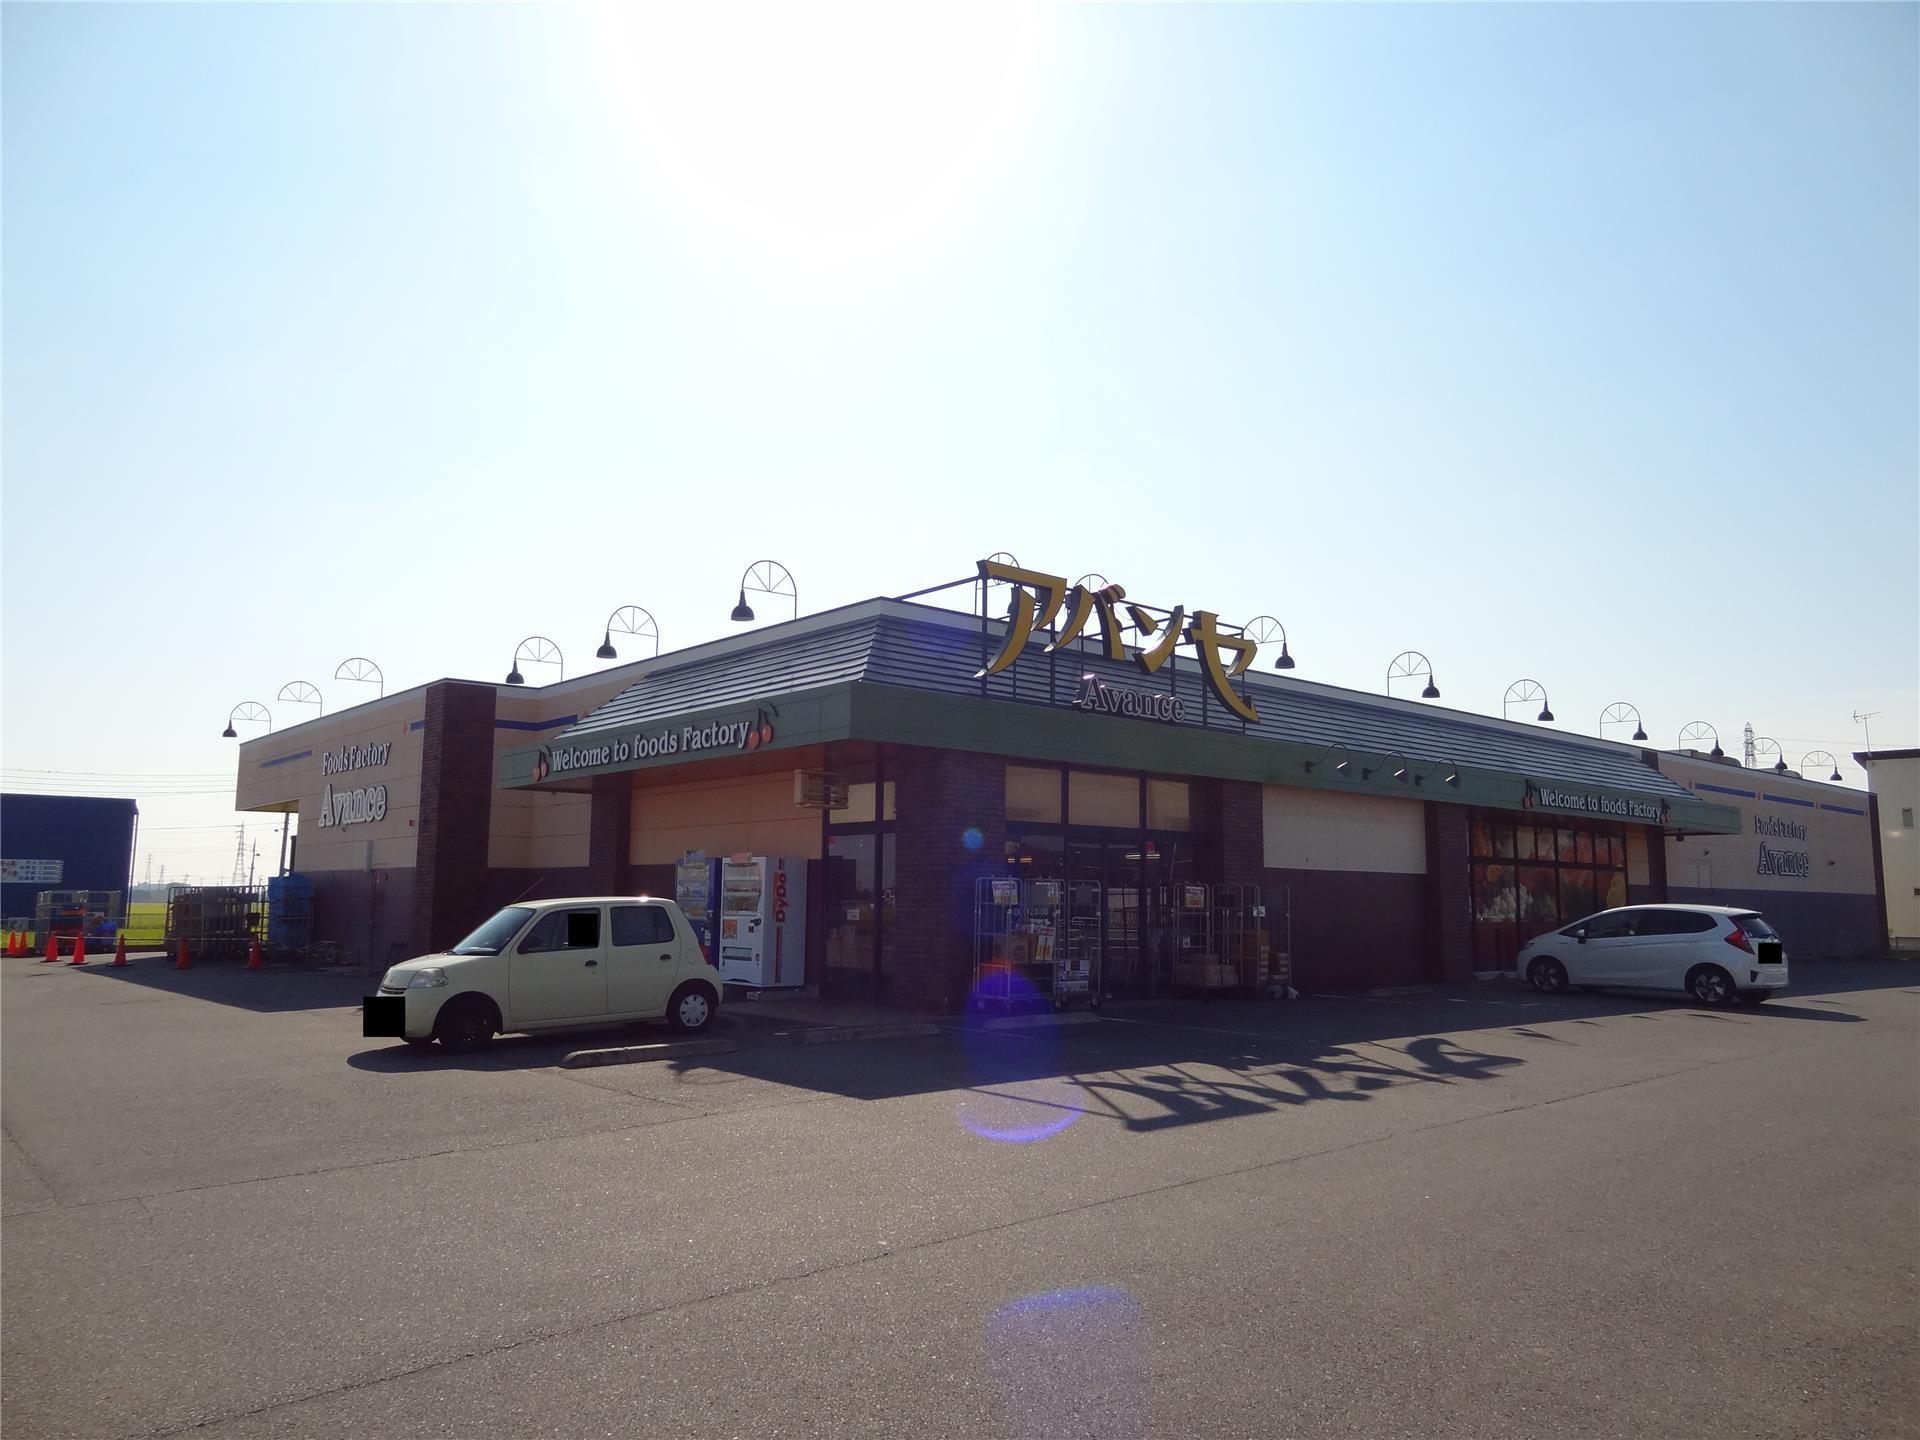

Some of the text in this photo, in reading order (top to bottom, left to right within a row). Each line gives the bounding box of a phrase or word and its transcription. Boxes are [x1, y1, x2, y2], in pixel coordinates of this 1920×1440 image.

[973, 560, 1259, 723] アバンセ
[1076, 673, 1185, 723] Avance
[322, 742, 392, 776] Foods Factory
[552, 719, 752, 772] Welcome to foods Factory
[318, 783, 387, 828] Avance
[1539, 788, 1661, 823] Welcome to foods Factory
[1757, 841, 1809, 878] Avance
